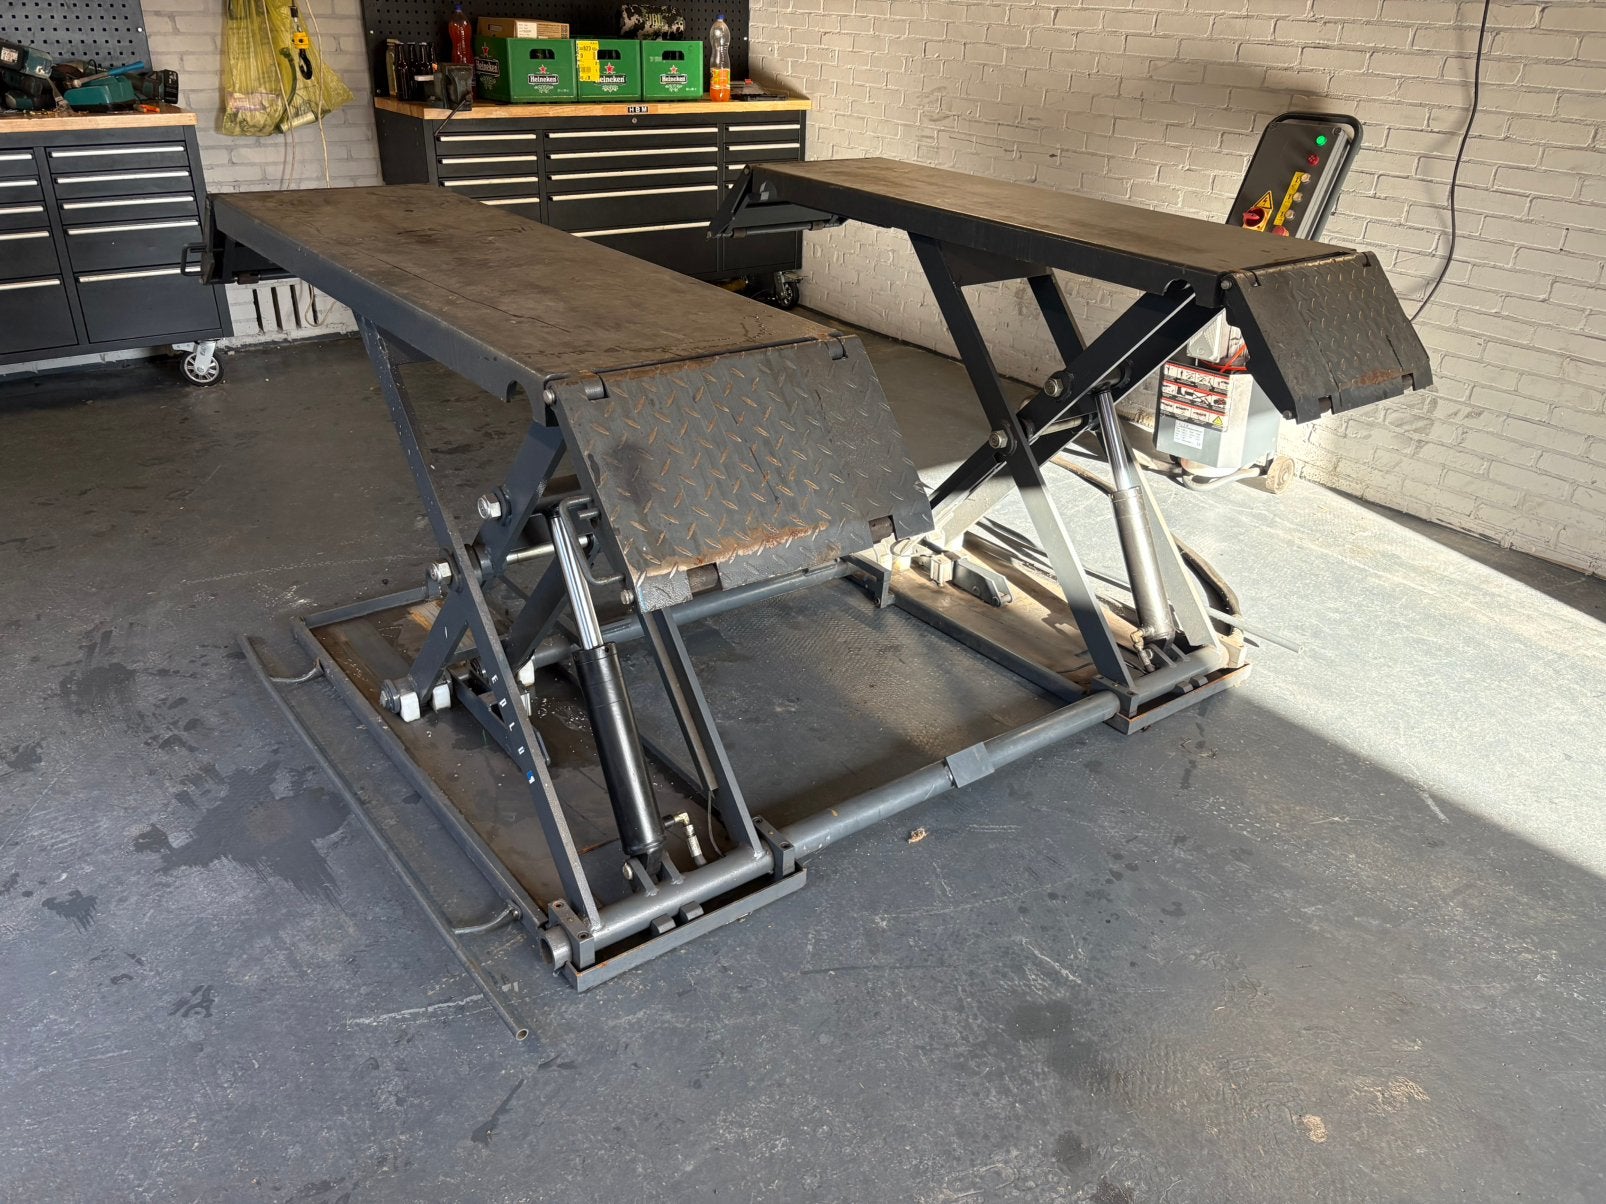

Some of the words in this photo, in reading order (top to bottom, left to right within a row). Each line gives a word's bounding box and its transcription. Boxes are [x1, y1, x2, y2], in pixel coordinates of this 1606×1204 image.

[646, 13, 663, 26] JBL
[475, 60, 498, 73] Heineken
[530, 75, 557, 83] Heineken
